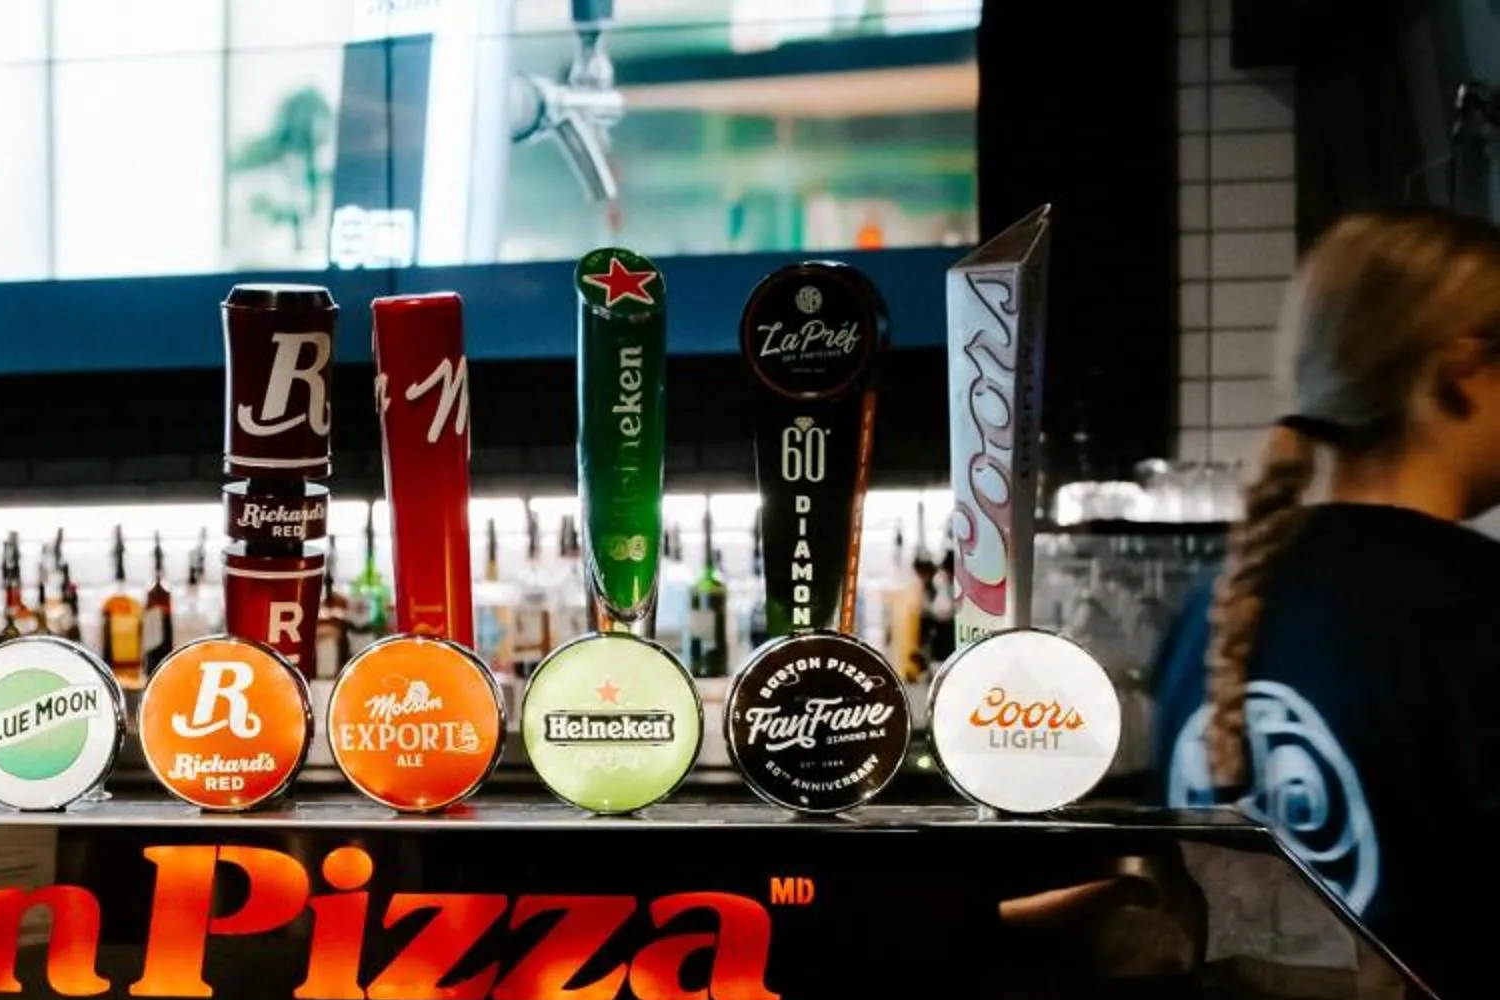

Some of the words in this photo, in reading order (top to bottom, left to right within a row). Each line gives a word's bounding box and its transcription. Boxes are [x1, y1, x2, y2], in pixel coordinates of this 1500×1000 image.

[236, 332, 332, 437] R
[612, 346, 643, 470] eken
[272, 525, 307, 538] RED
[791, 495, 814, 633] DIAMON
[759, 657, 821, 699] BOSTON
[827, 658, 875, 692] PIZZA
[34, 689, 99, 727] MOON
[171, 661, 262, 739] R
[969, 687, 1085, 730] Coors
[549, 713, 672, 741] Heineken
[989, 729, 1064, 751] LIGHT
[167, 752, 276, 780] Rickard's
[396, 754, 425, 767] ALE
[205, 776, 245, 791] RED
[770, 877, 815, 906] MD
